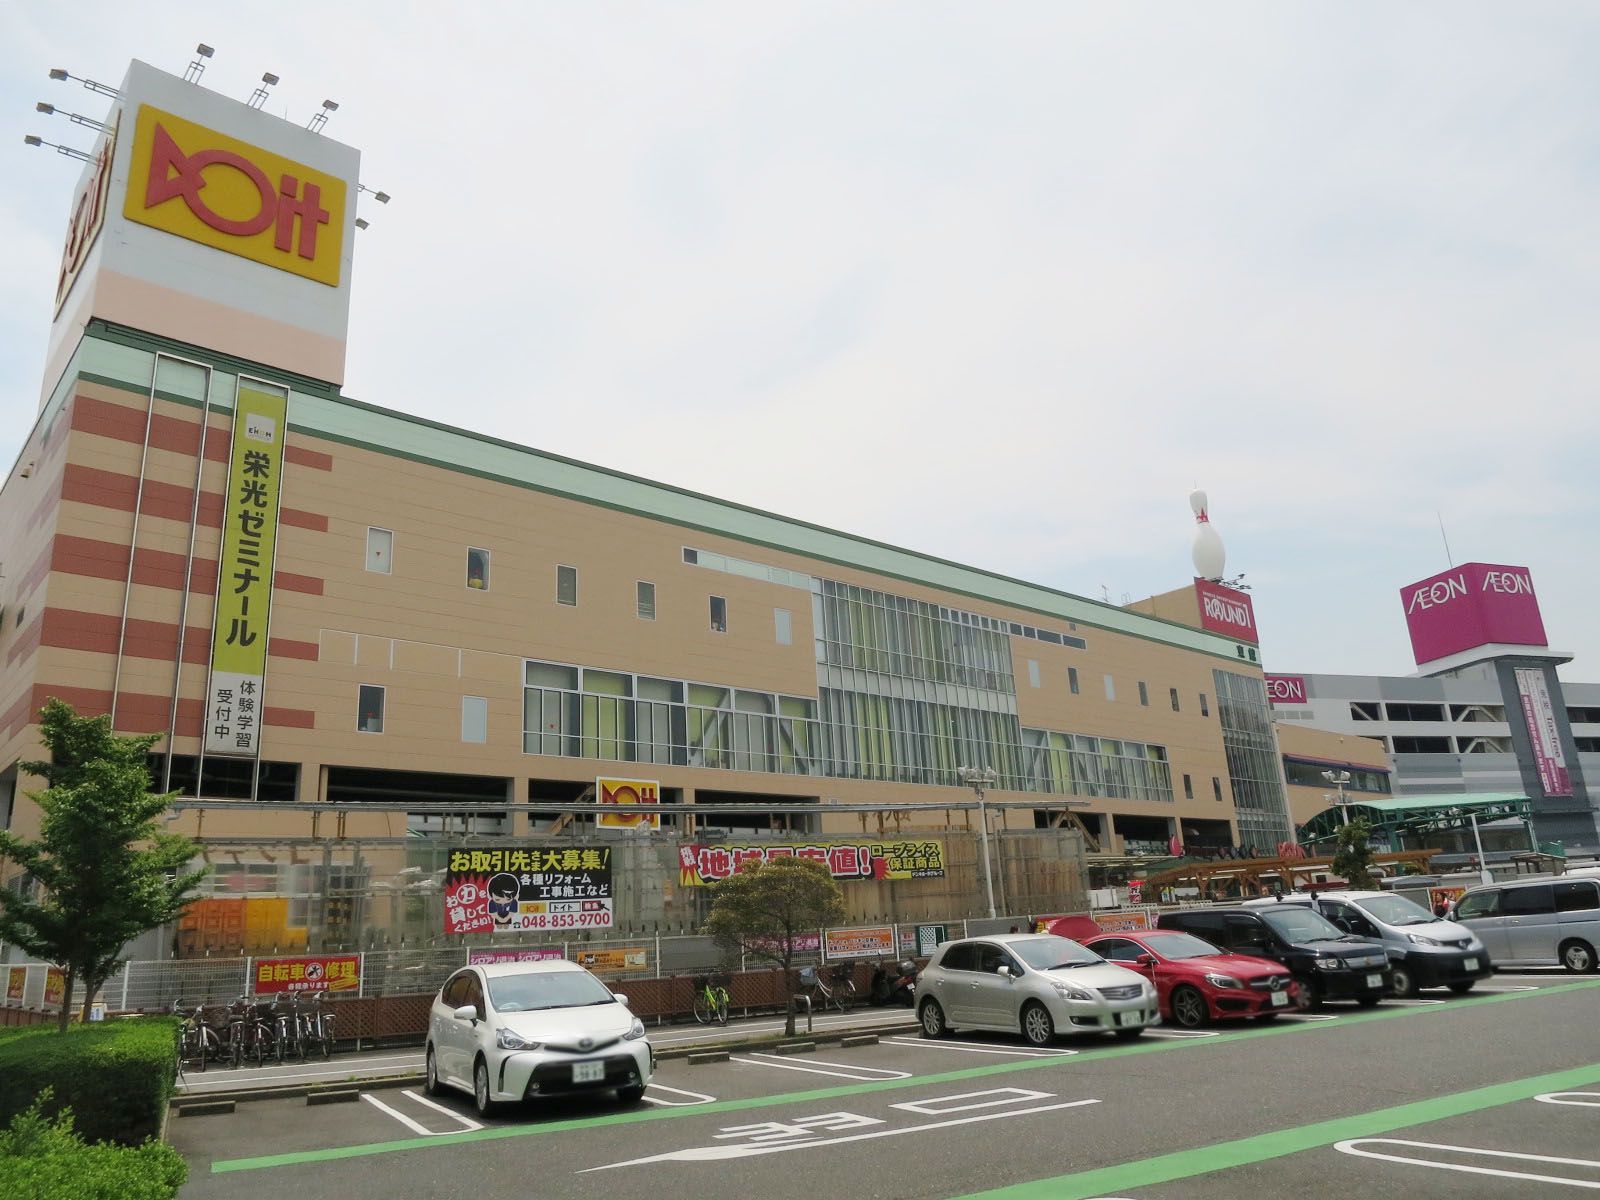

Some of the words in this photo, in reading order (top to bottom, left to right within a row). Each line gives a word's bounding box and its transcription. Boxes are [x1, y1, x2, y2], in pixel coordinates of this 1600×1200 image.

[226, 450, 271, 647] 栄光ゼミナール
[214, 689, 233, 739] 受付中
[236, 680, 256, 748] 体験学習
[871, 842, 940, 857] ロープライス
[889, 855, 941, 871] 保証商品
[520, 873, 592, 886] 各種リフォーム
[539, 884, 608, 898] 工事施工など
[522, 912, 610, 928] 048-853-9700
[258, 963, 306, 982] 自転車
[325, 961, 356, 979] 修理
